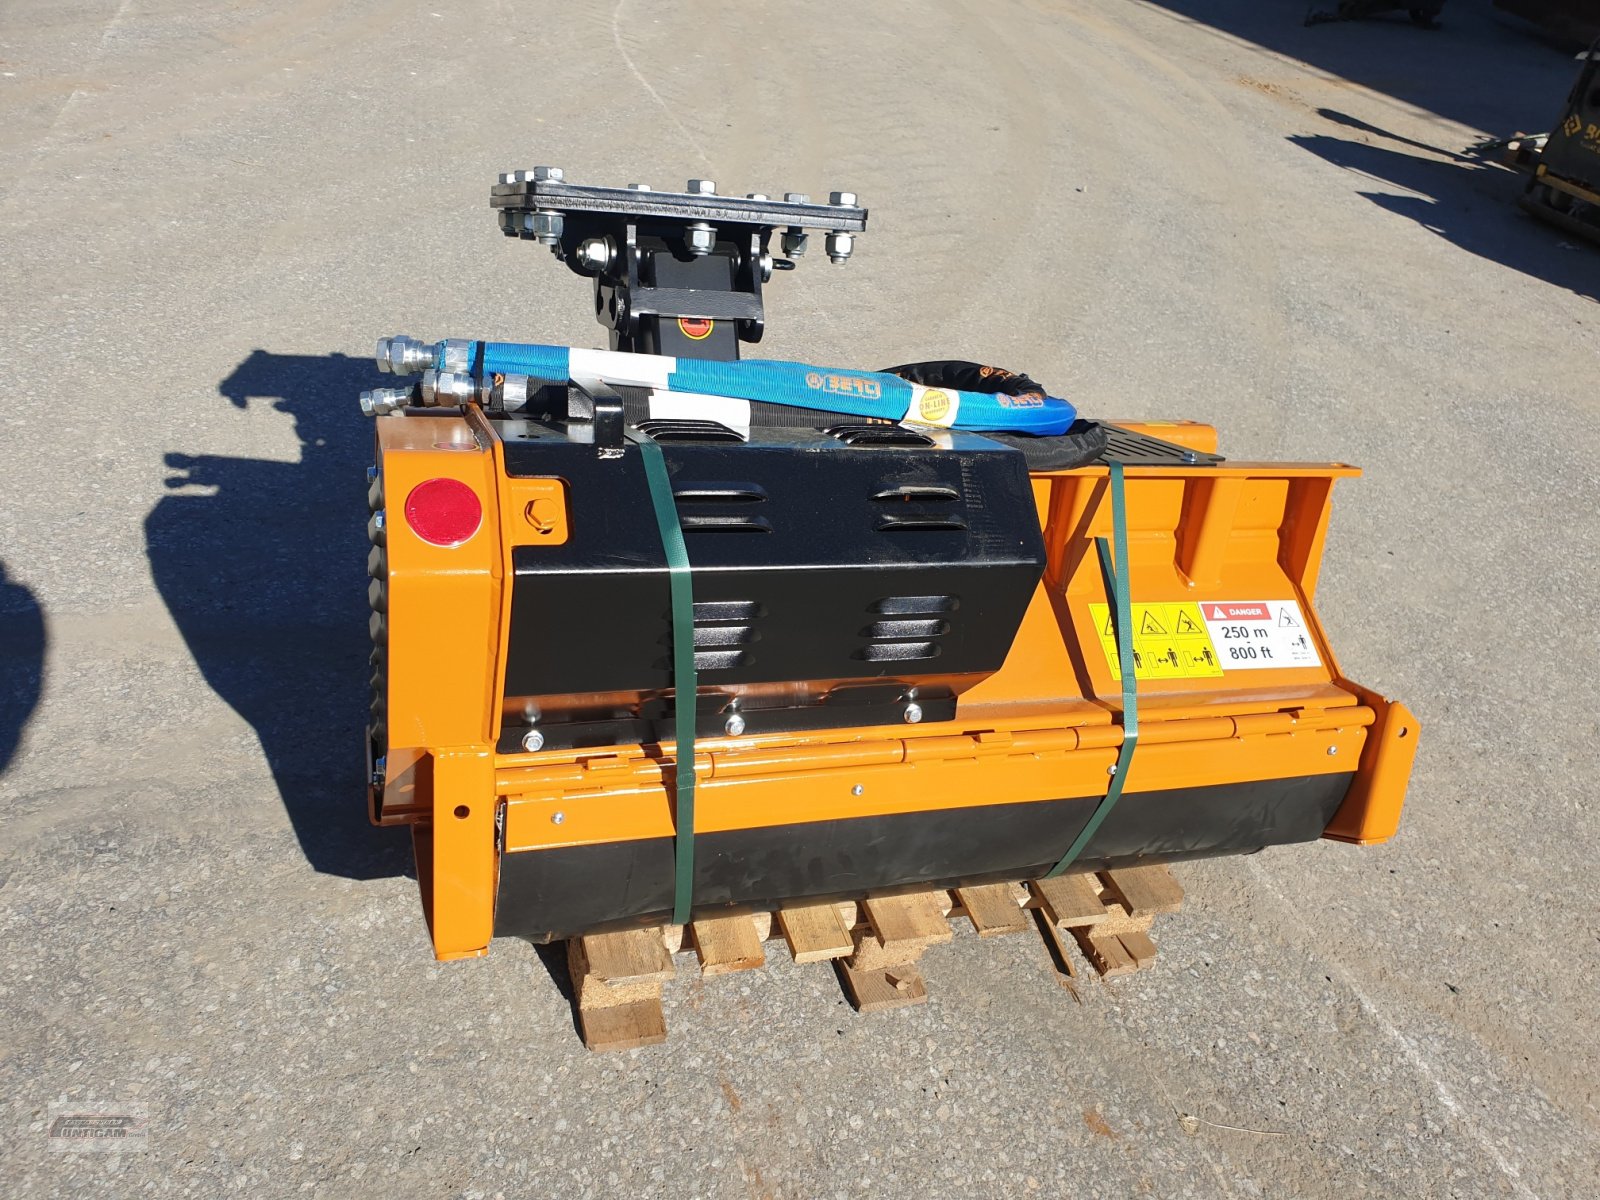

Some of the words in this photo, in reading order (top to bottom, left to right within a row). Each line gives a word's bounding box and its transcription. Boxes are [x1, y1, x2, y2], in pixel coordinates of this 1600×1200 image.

[1228, 607, 1263, 616] DANGER
[1221, 626, 1249, 639] 250
[1253, 627, 1269, 638] m
[1229, 646, 1257, 660] 800
[1260, 645, 1274, 659] ft
